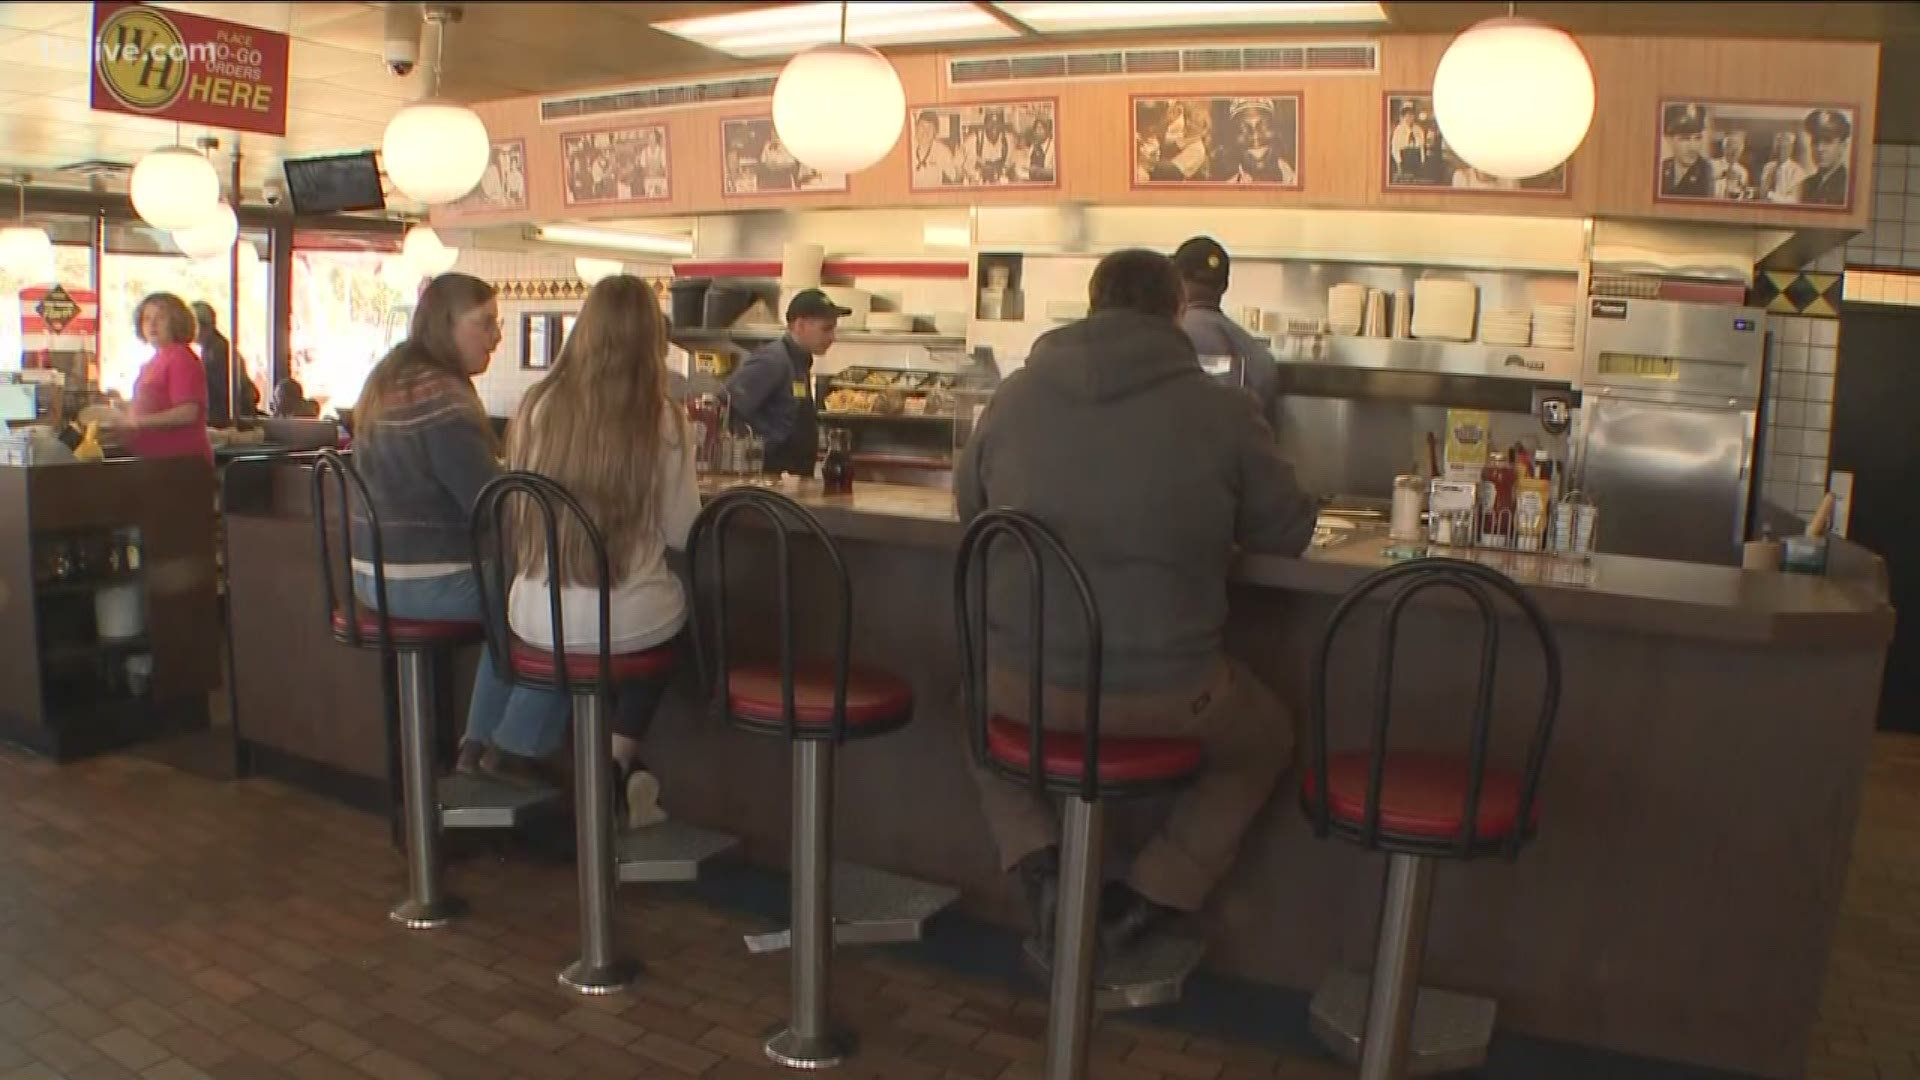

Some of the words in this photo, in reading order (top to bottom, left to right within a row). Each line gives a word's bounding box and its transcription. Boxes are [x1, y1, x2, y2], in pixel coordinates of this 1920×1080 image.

[217, 30, 253, 47] PLACE
[206, 60, 262, 80] ORDERS
[188, 73, 273, 112] HERE
